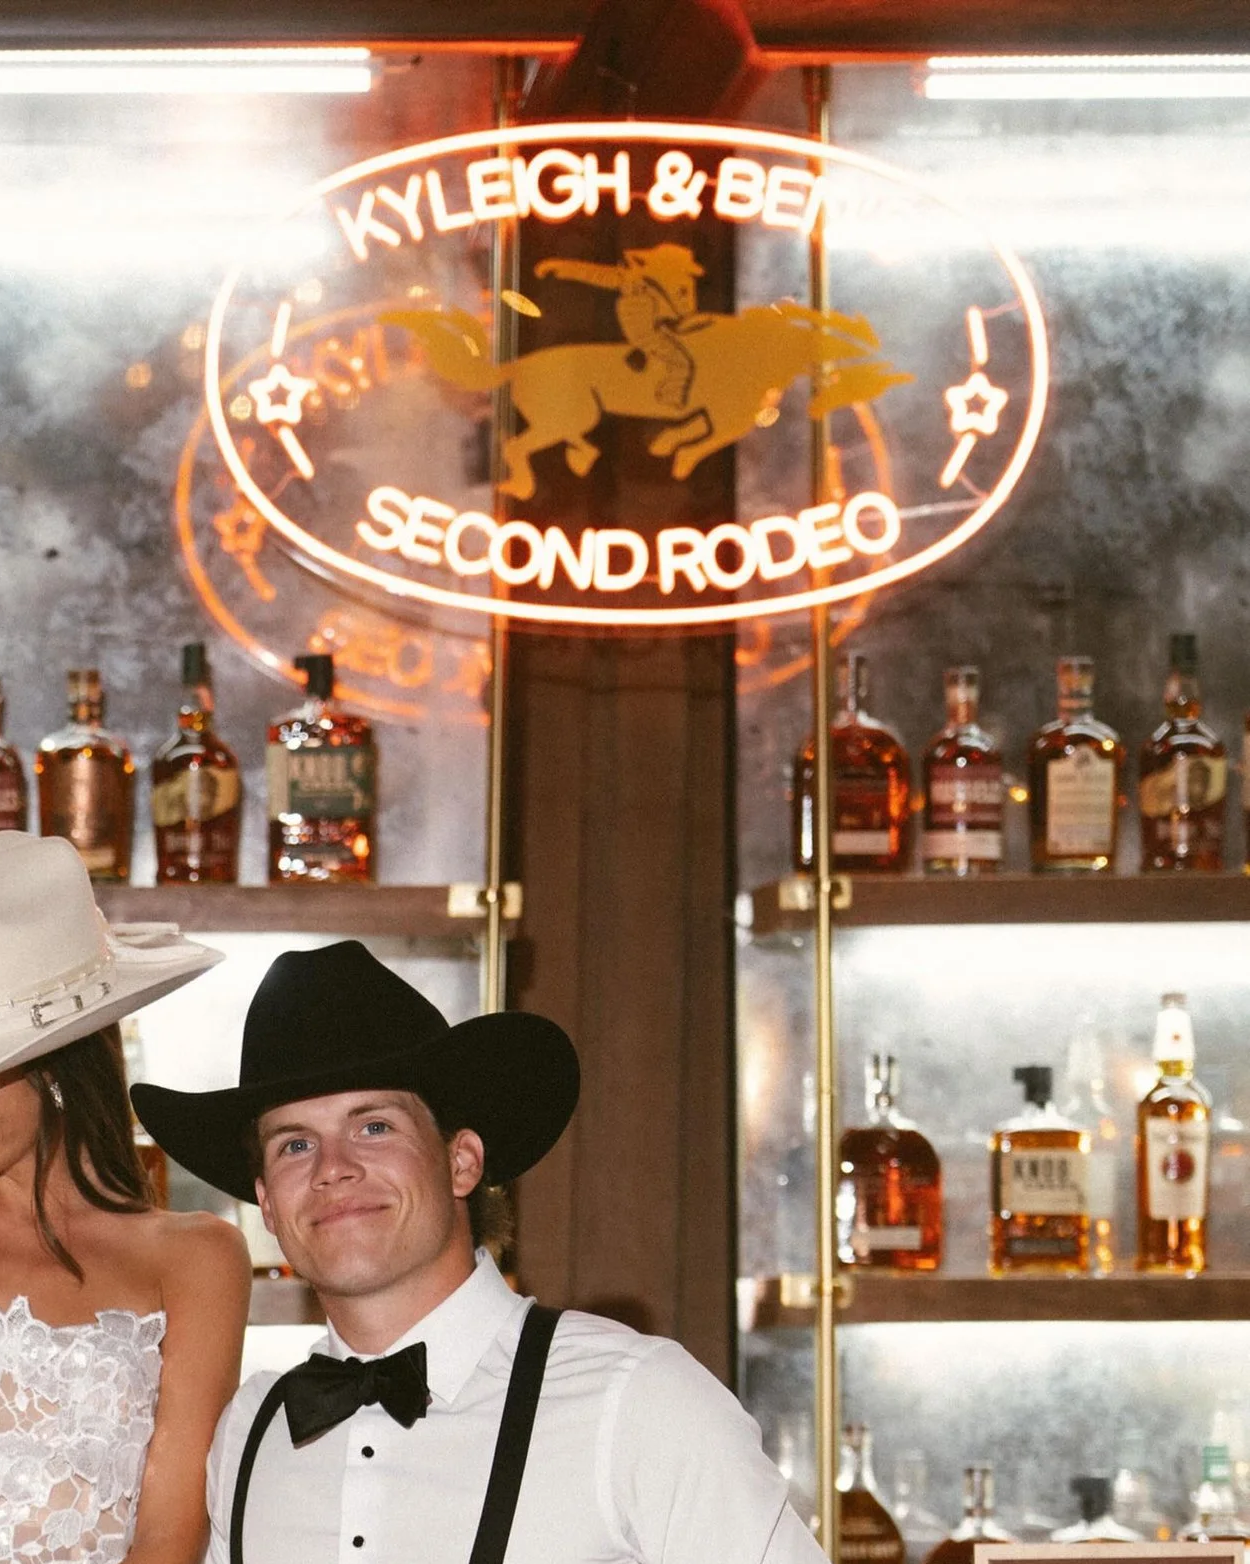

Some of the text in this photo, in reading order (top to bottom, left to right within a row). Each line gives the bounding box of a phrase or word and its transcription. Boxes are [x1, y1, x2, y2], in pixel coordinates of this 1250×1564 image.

[335, 147, 631, 261] KYLEIGH
[648, 150, 707, 219] &
[355, 485, 901, 595] SECOND RODEO
